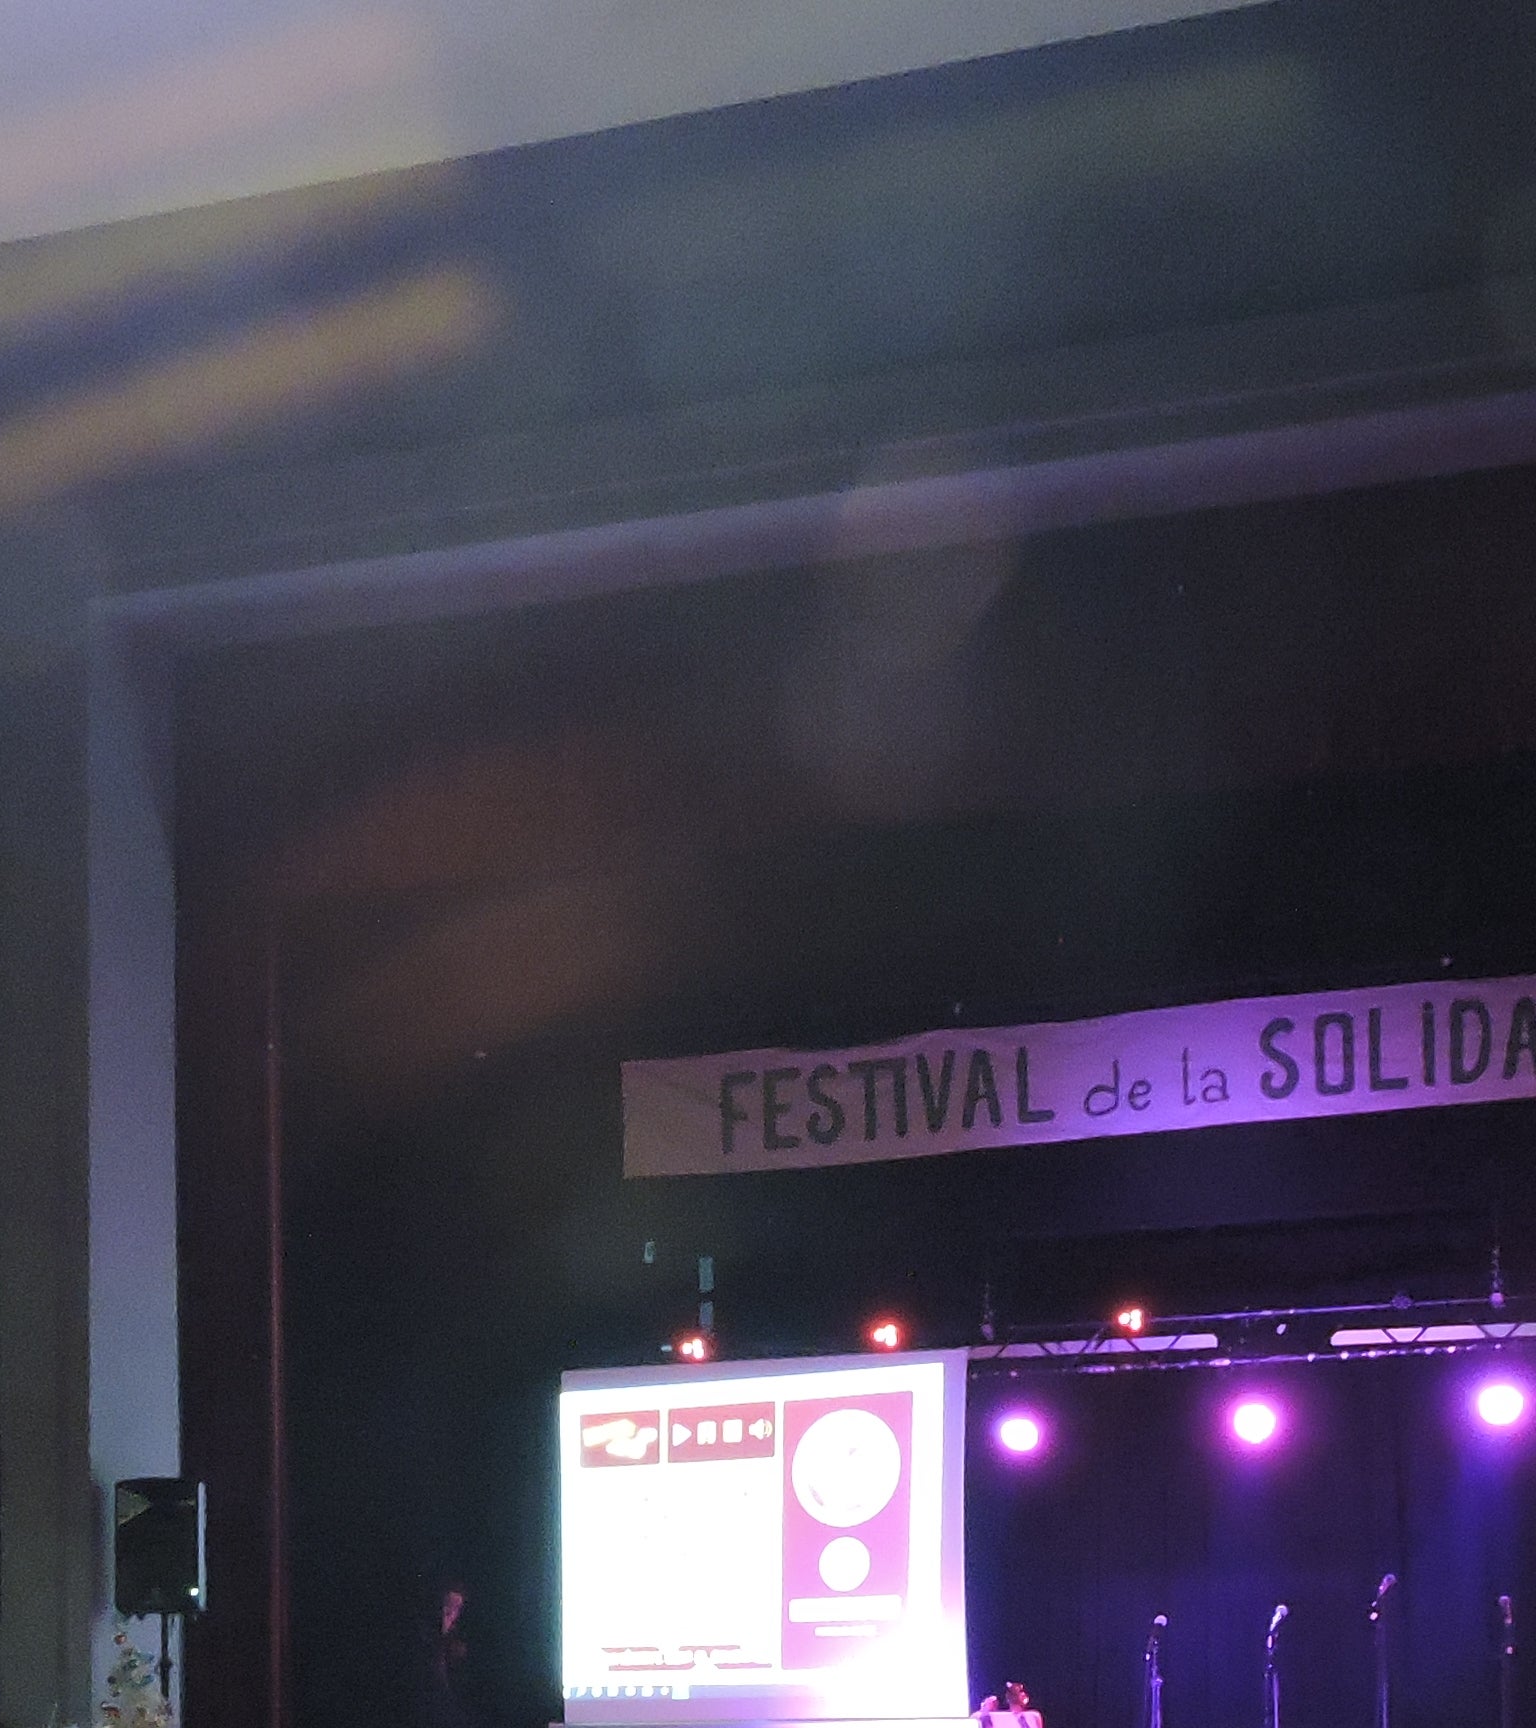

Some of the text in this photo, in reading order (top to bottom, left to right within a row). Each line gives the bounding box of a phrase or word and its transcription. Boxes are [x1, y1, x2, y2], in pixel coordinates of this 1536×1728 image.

[718, 1046, 1056, 1154] FESTIVAL
[1083, 1059, 1152, 1117] de
[1181, 1047, 1230, 1106] la
